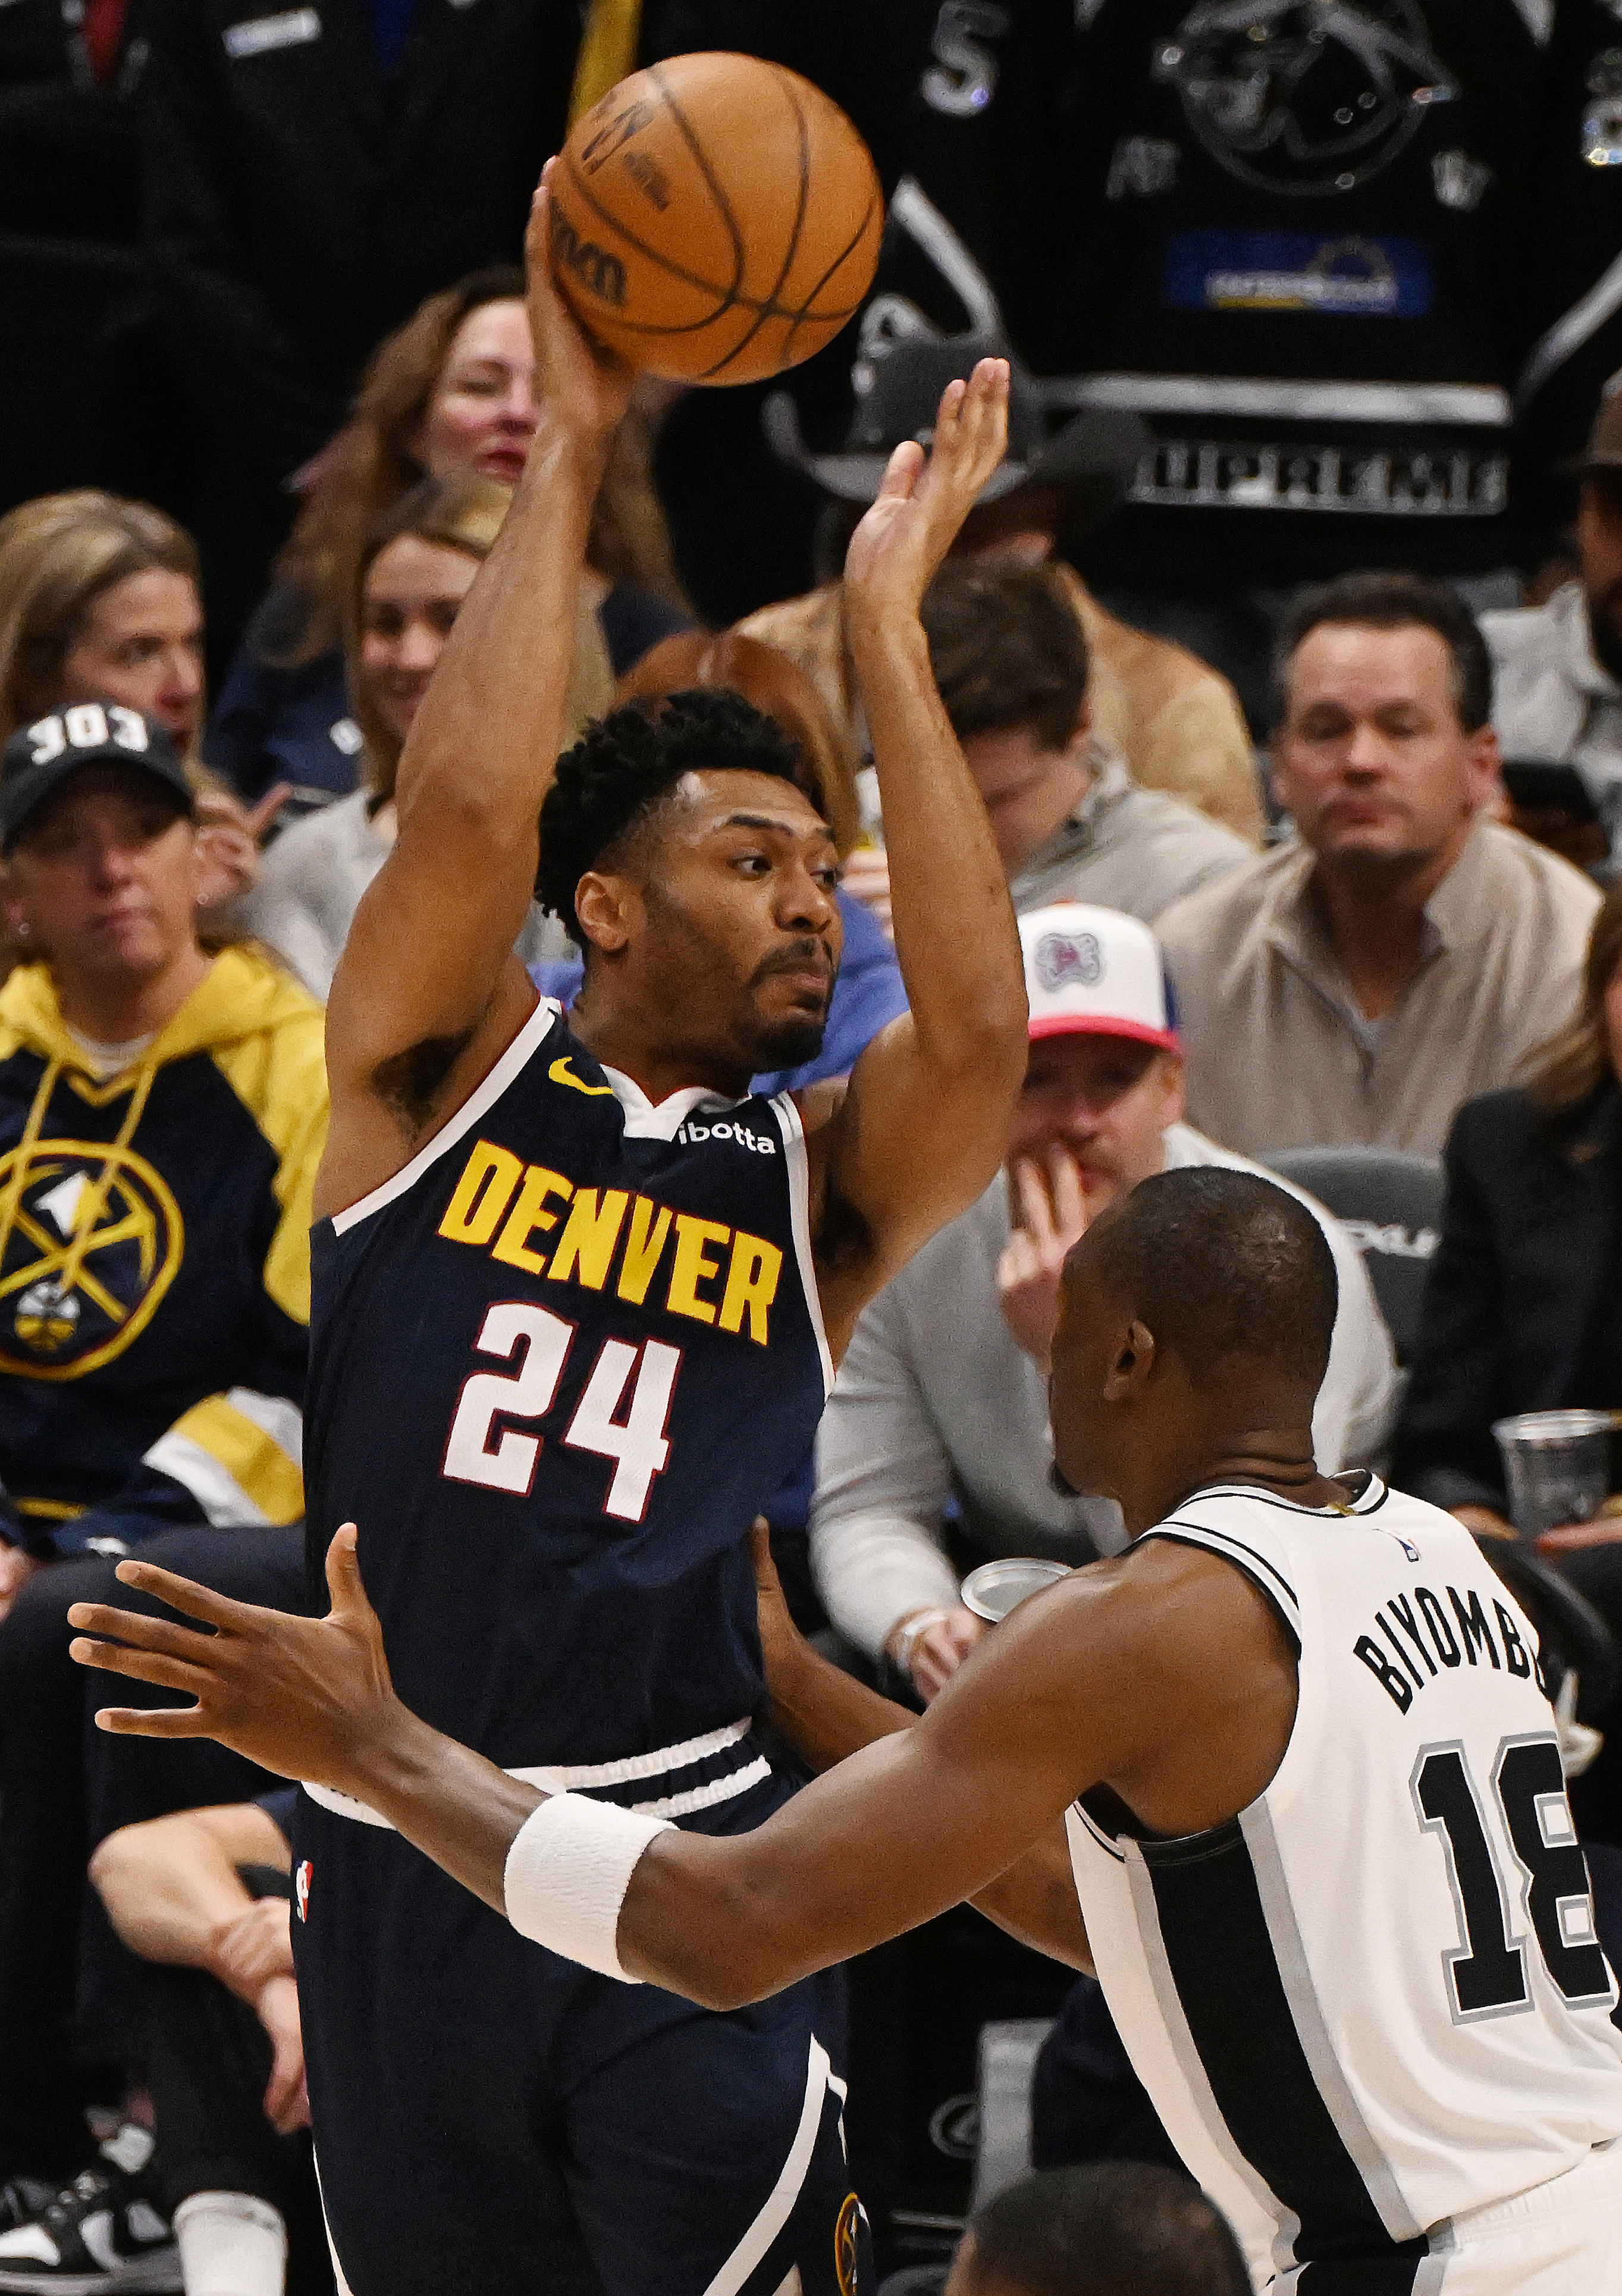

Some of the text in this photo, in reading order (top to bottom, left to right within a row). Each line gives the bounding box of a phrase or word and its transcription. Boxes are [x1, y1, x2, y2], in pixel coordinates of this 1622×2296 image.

[437, 1137, 783, 1347] DENVER
[679, 1122, 776, 1155] ibotta
[441, 1299, 683, 1524] 24
[1353, 1586, 1548, 1715] BIYOMB
[1408, 1731, 1615, 2027] 18
